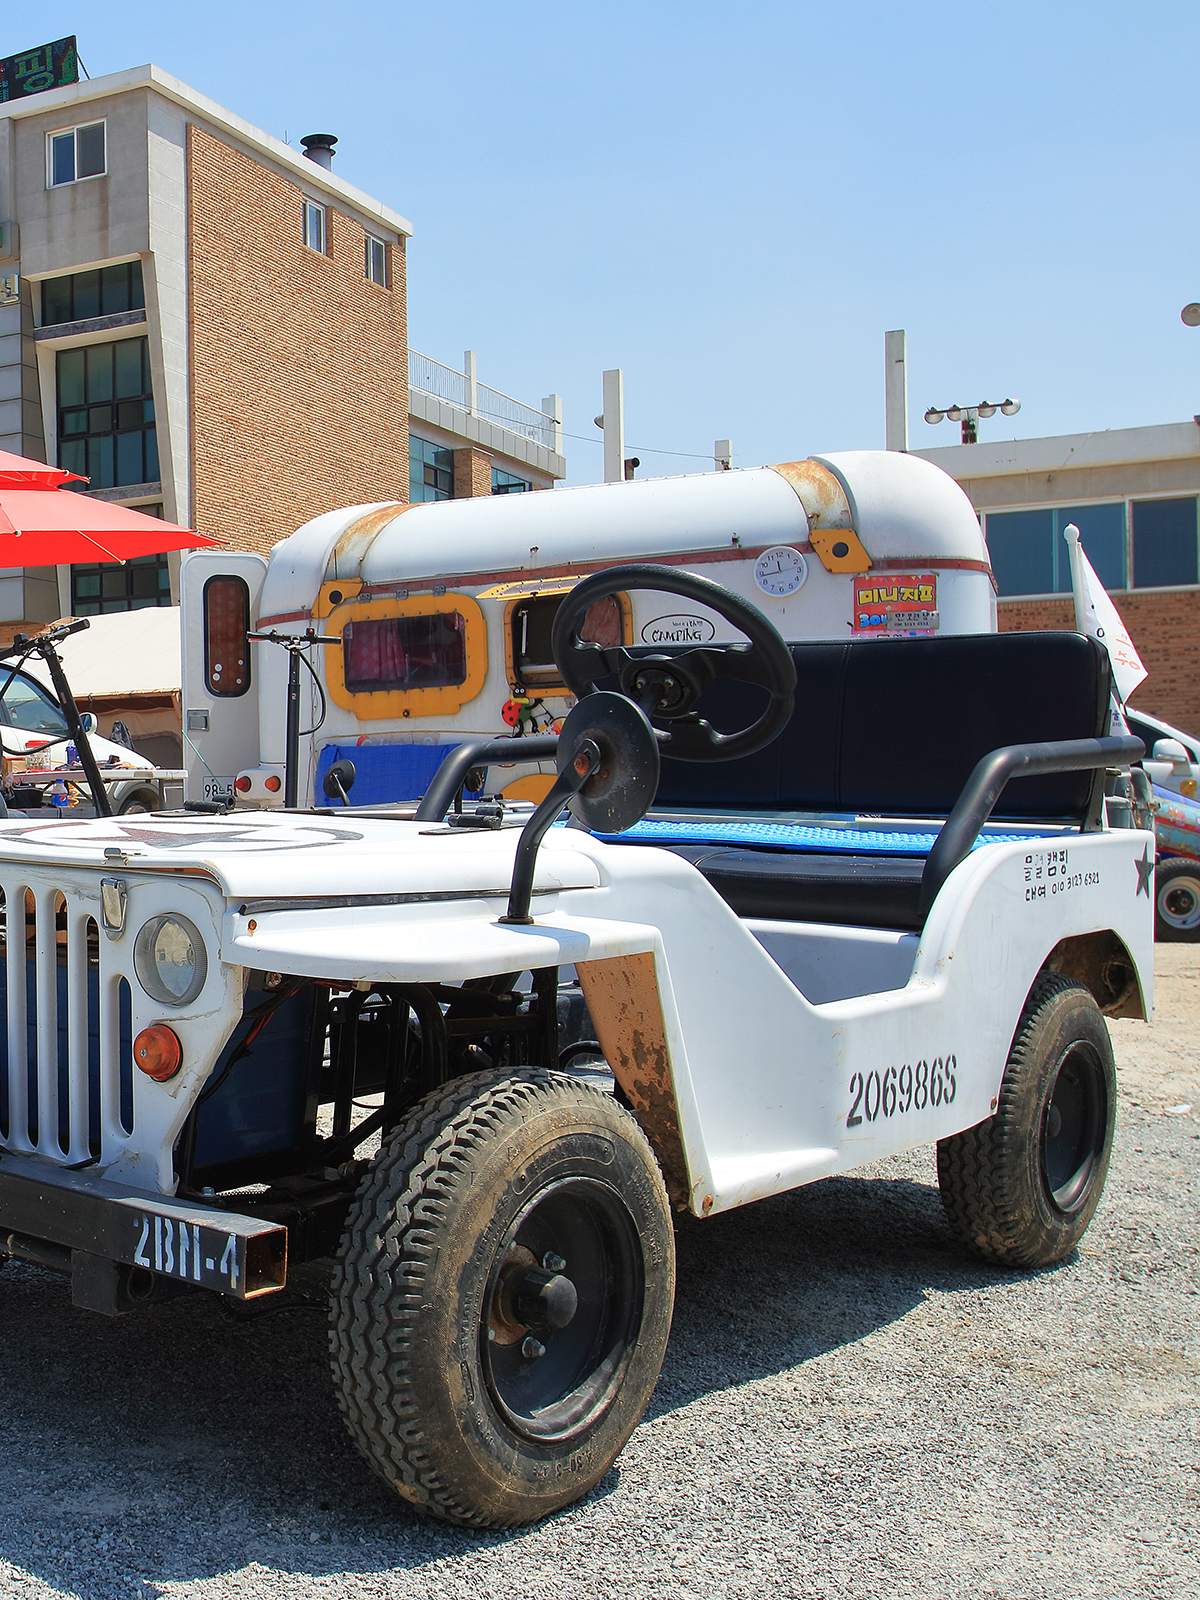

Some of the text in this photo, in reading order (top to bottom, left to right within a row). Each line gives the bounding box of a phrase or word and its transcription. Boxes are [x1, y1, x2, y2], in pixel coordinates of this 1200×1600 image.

[857, 583, 934, 605] 미니지프
[651, 628, 702, 642] CAMPING
[1047, 849, 1068, 877] 캠핑
[1025, 872, 1100, 901] 대여 010 3123 6521
[133, 1213, 239, 1289] 2BN-4
